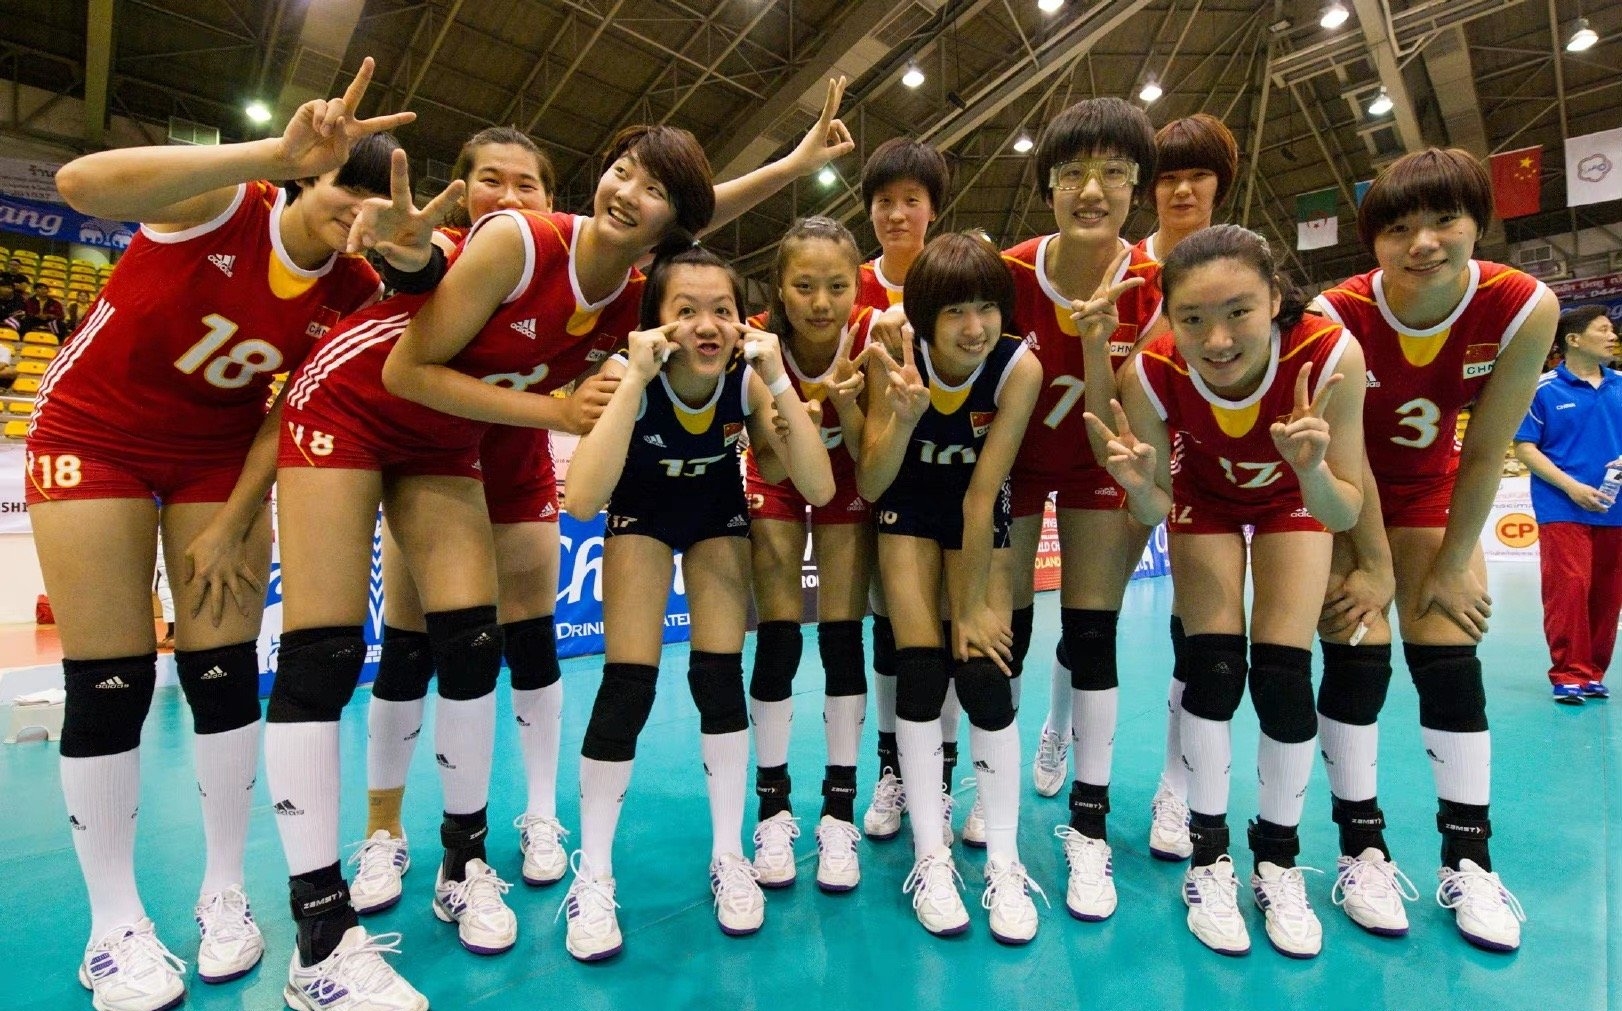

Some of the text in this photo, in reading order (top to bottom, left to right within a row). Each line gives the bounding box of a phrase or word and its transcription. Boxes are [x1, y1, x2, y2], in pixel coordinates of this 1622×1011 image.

[510, 322, 537, 340] adidas
[173, 313, 284, 389] 18
[1110, 344, 1133, 354] CHN
[1390, 398, 1441, 449] 3
[38, 454, 82, 489] 18
[1501, 523, 1534, 539] CP
[555, 621, 605, 640] DRIN
